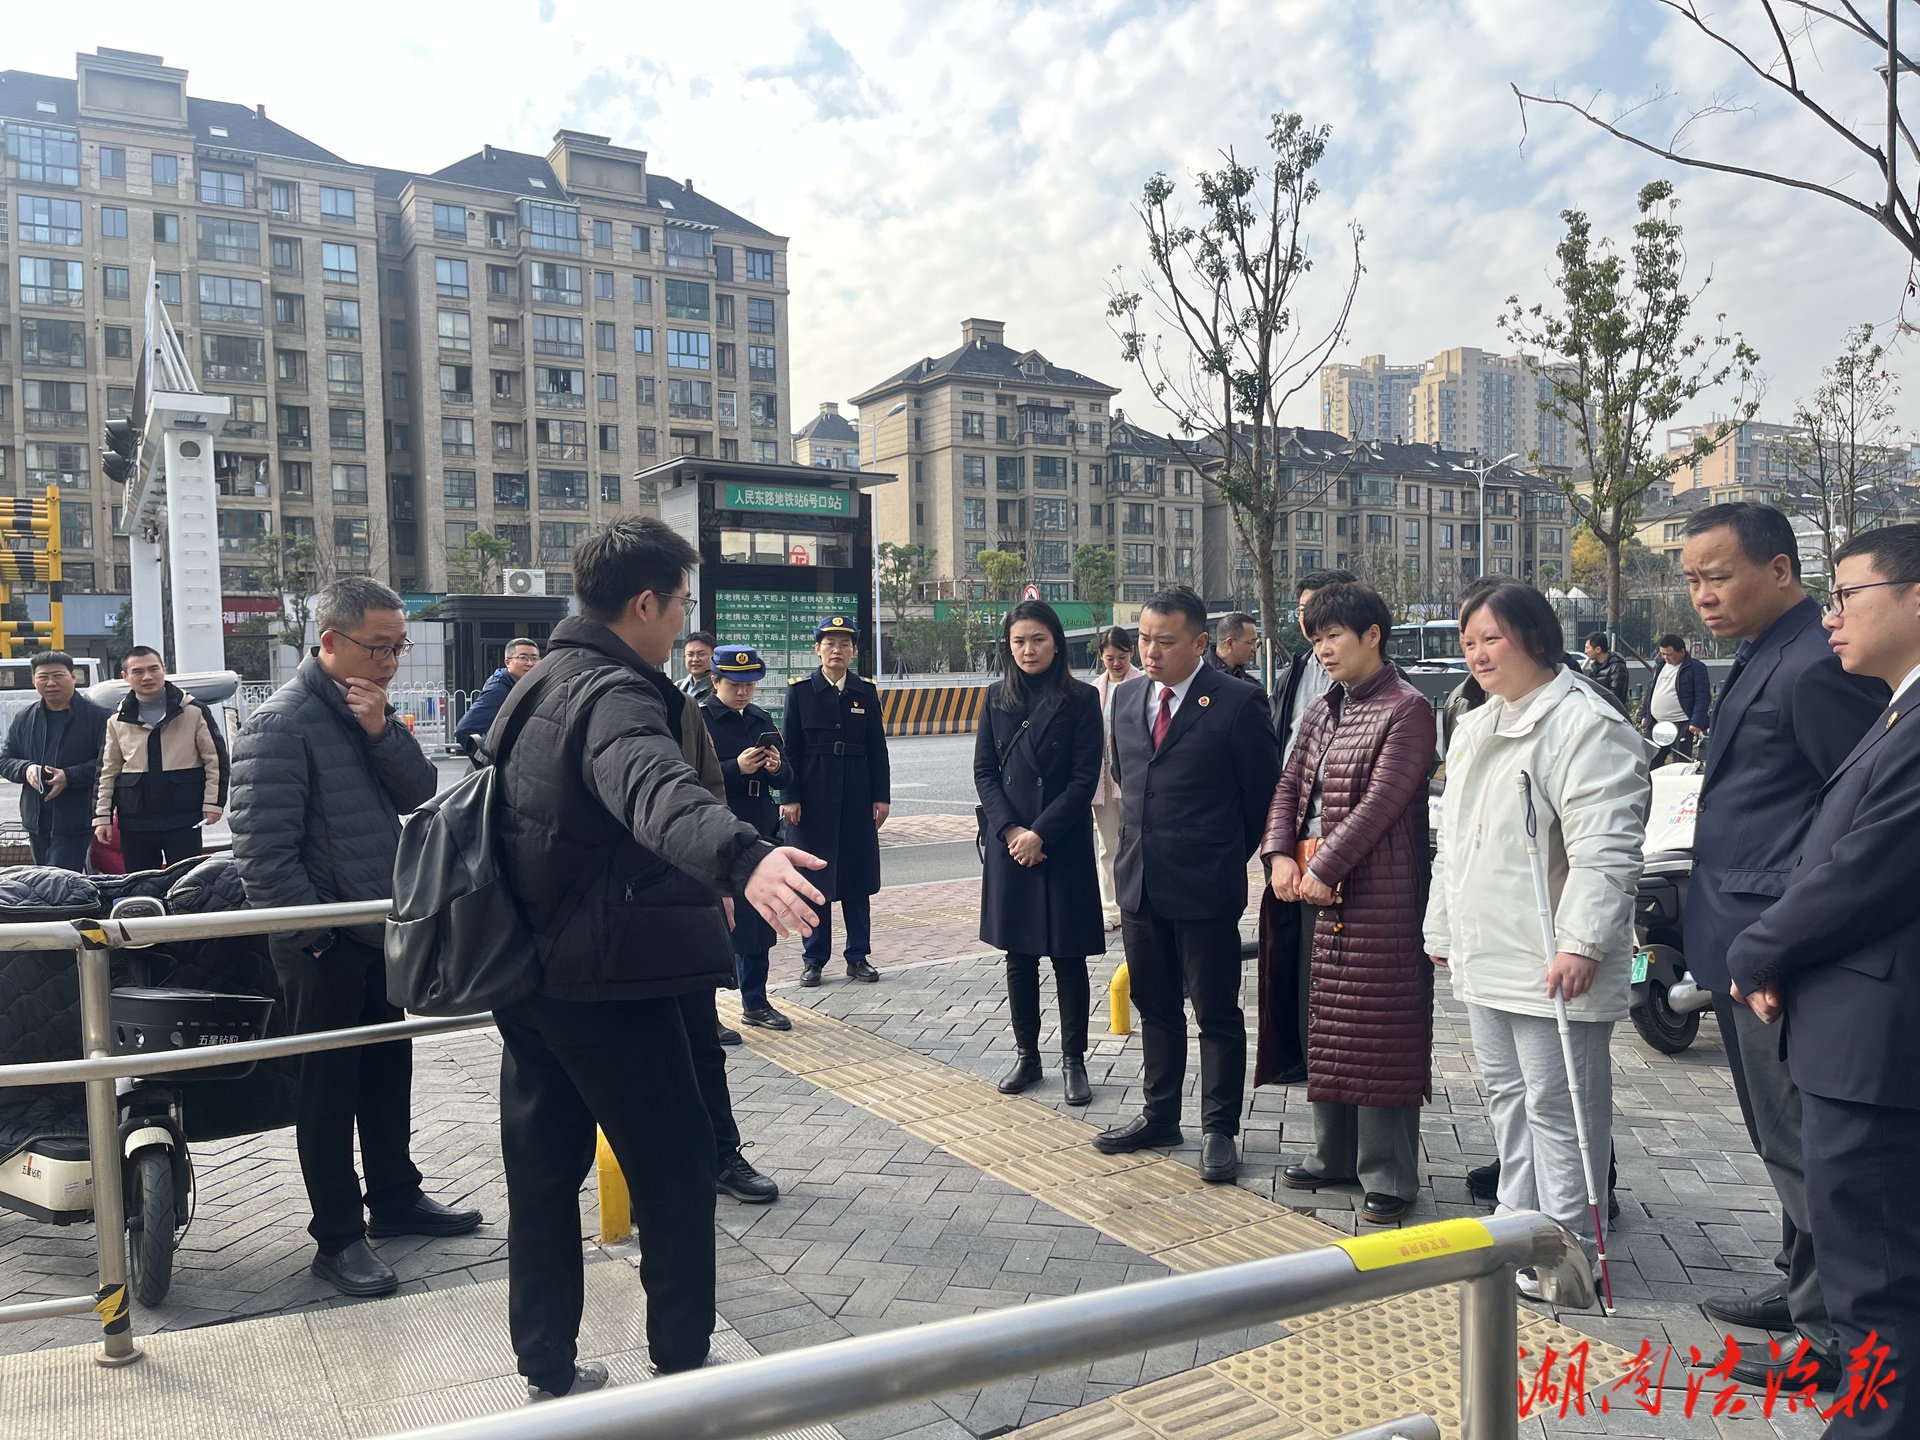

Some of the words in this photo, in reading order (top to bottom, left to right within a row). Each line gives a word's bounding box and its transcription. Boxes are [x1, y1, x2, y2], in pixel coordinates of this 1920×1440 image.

[735, 489, 842, 510] 人民东路地铁站6号口站
[753, 594, 787, 602] 先下后上
[826, 596, 858, 604] 先下后上
[753, 613, 787, 621] 先下后上
[754, 633, 787, 641] 先下后上
